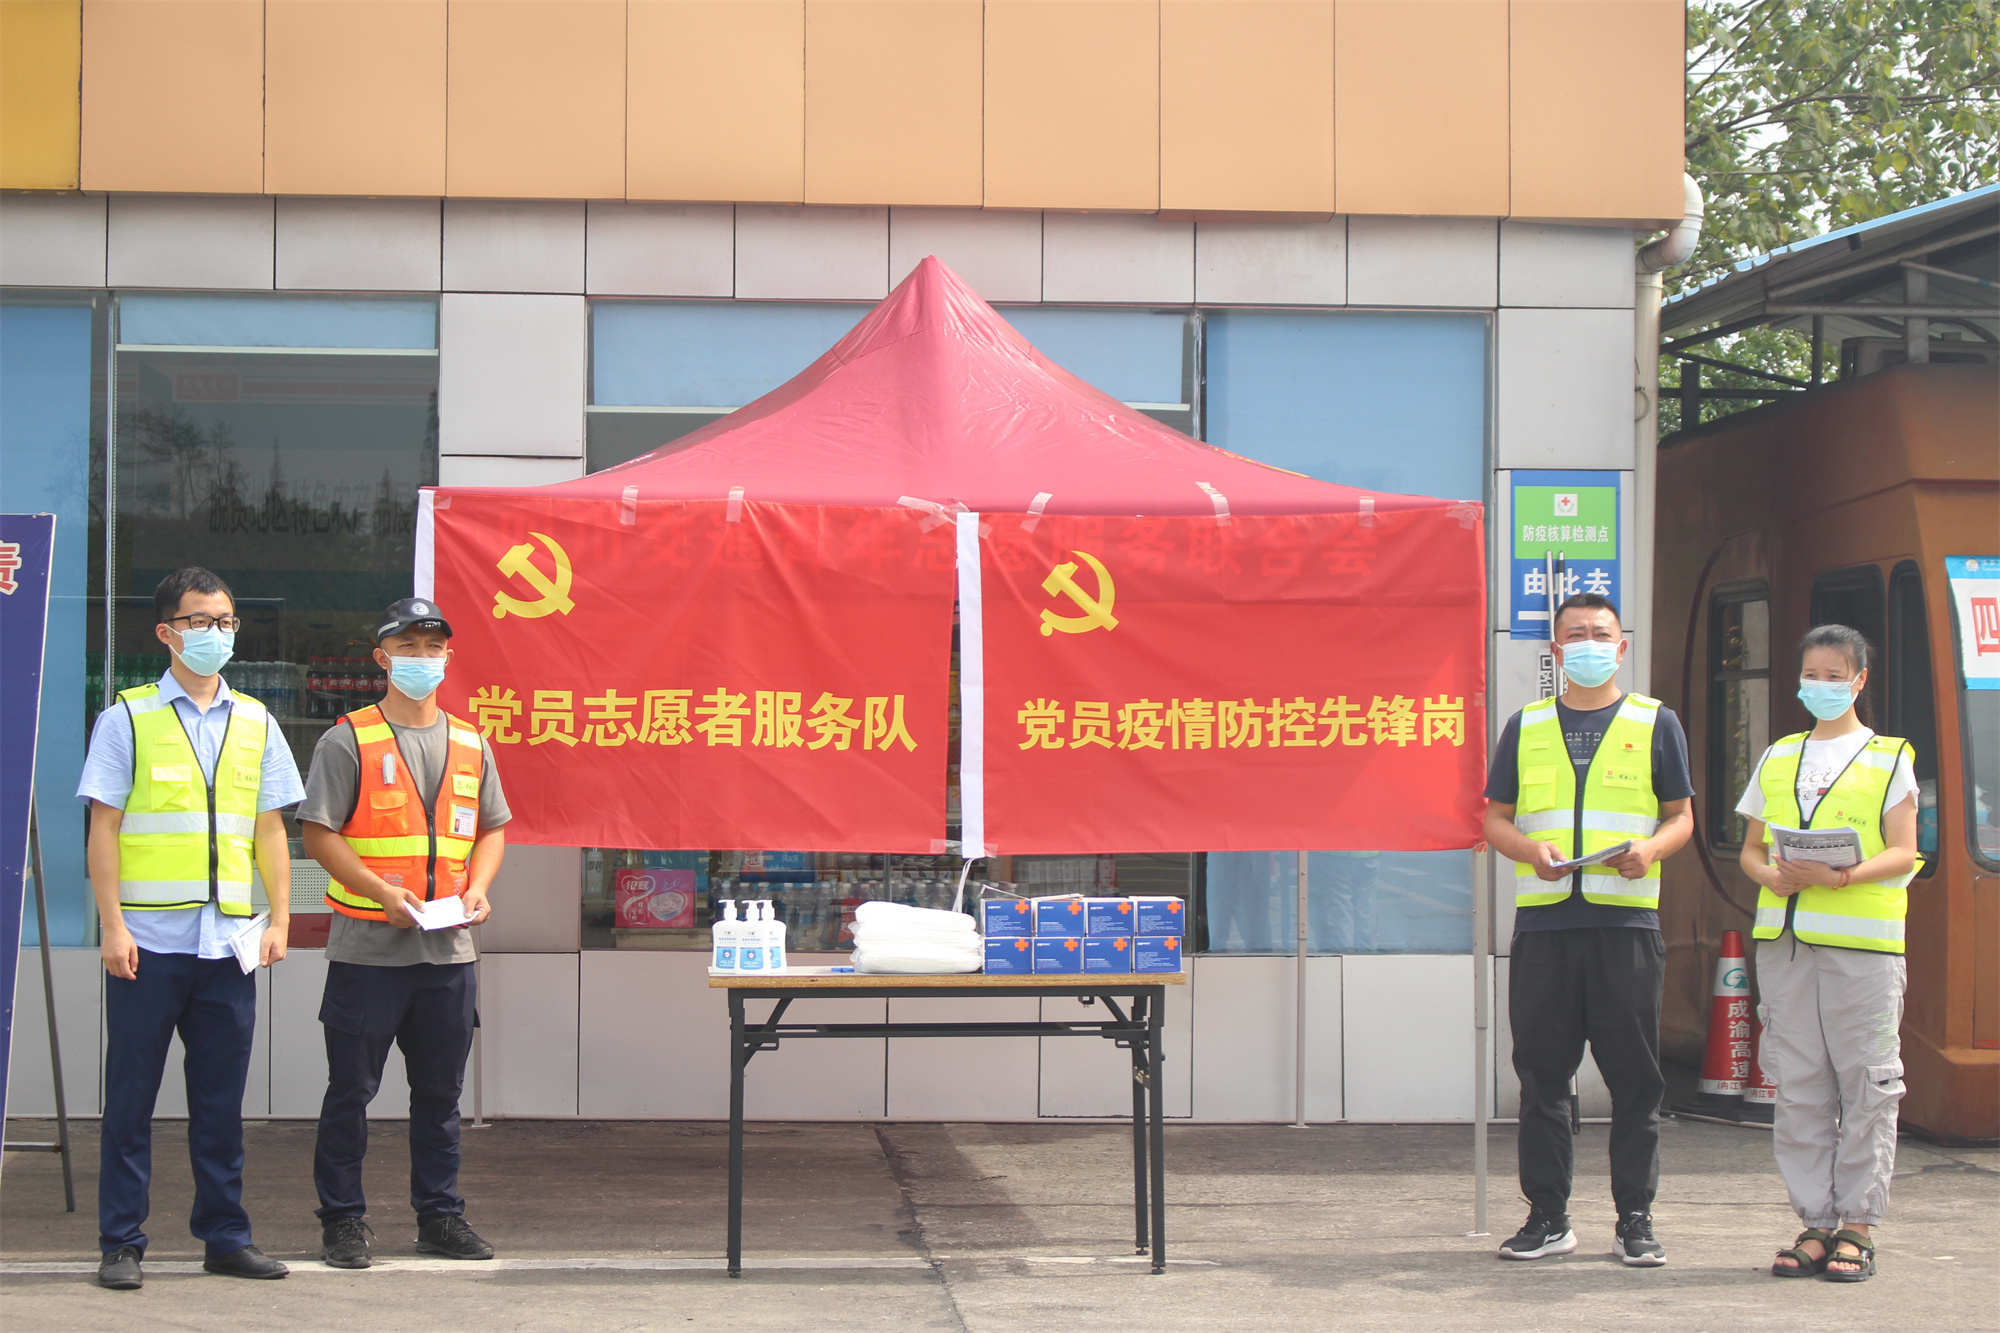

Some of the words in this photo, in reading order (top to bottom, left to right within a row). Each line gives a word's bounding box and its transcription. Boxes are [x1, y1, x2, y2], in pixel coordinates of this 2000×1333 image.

[1523, 525, 1609, 543] 防疫核算检测点
[468, 685, 918, 752] 党员志愿者服务队
[1017, 693, 1466, 751] 党员疫情防控先锋岗
[1727, 1000, 1752, 1078] 成渝高速
